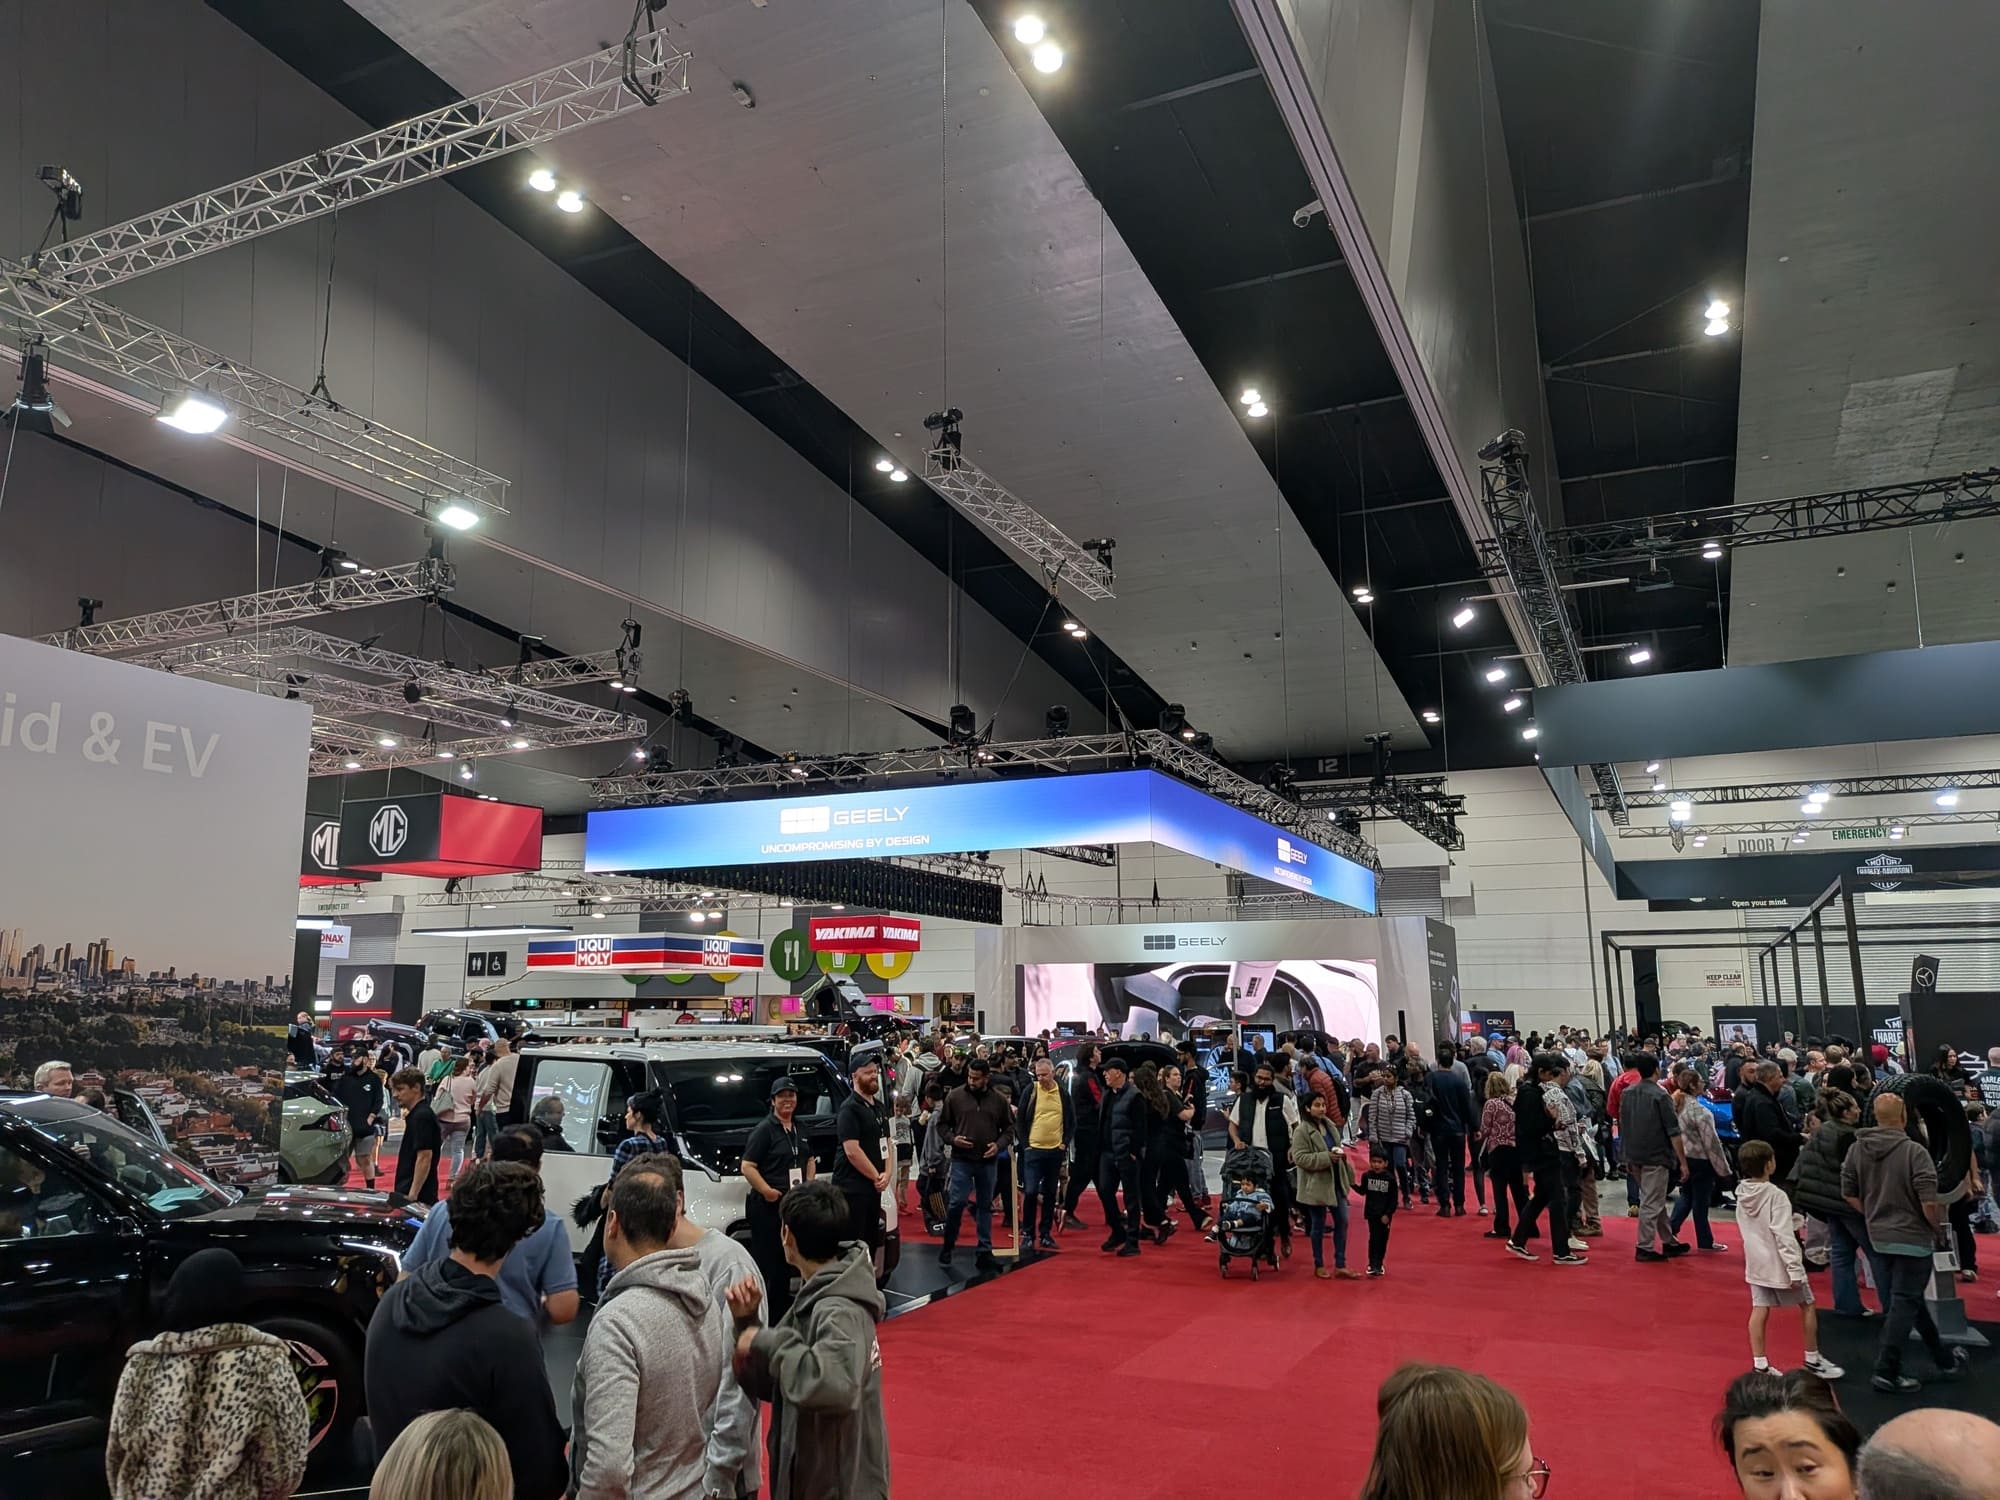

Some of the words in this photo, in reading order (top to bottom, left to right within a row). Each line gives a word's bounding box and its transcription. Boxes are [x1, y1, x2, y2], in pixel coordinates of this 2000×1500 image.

[82, 711, 120, 765] &
[143, 720, 221, 778] EV
[1318, 758, 1338, 773] 12
[833, 806, 910, 825] GEELY
[371, 807, 406, 854] MG
[1832, 827, 1887, 840] EMERGENCY
[761, 839, 863, 854] UNCOMPROMISING
[866, 838, 883, 848] BY
[885, 835, 930, 847] DESIGN
[1738, 837, 1775, 852] DOOR
[1781, 837, 1790, 851] 7
[1870, 856, 1897, 866] MOTOR
[1768, 898, 1788, 906] mind.
[815, 926, 875, 940] YAKIMA
[882, 926, 919, 941] YAKIMA
[577, 939, 610, 953] LIQUI
[705, 940, 729, 953] LIQUI
[1178, 936, 1227, 946] GEELY
[577, 952, 610, 966] MOLY
[704, 953, 729, 966] MOLY
[1876, 1031, 1903, 1044] HARLE
